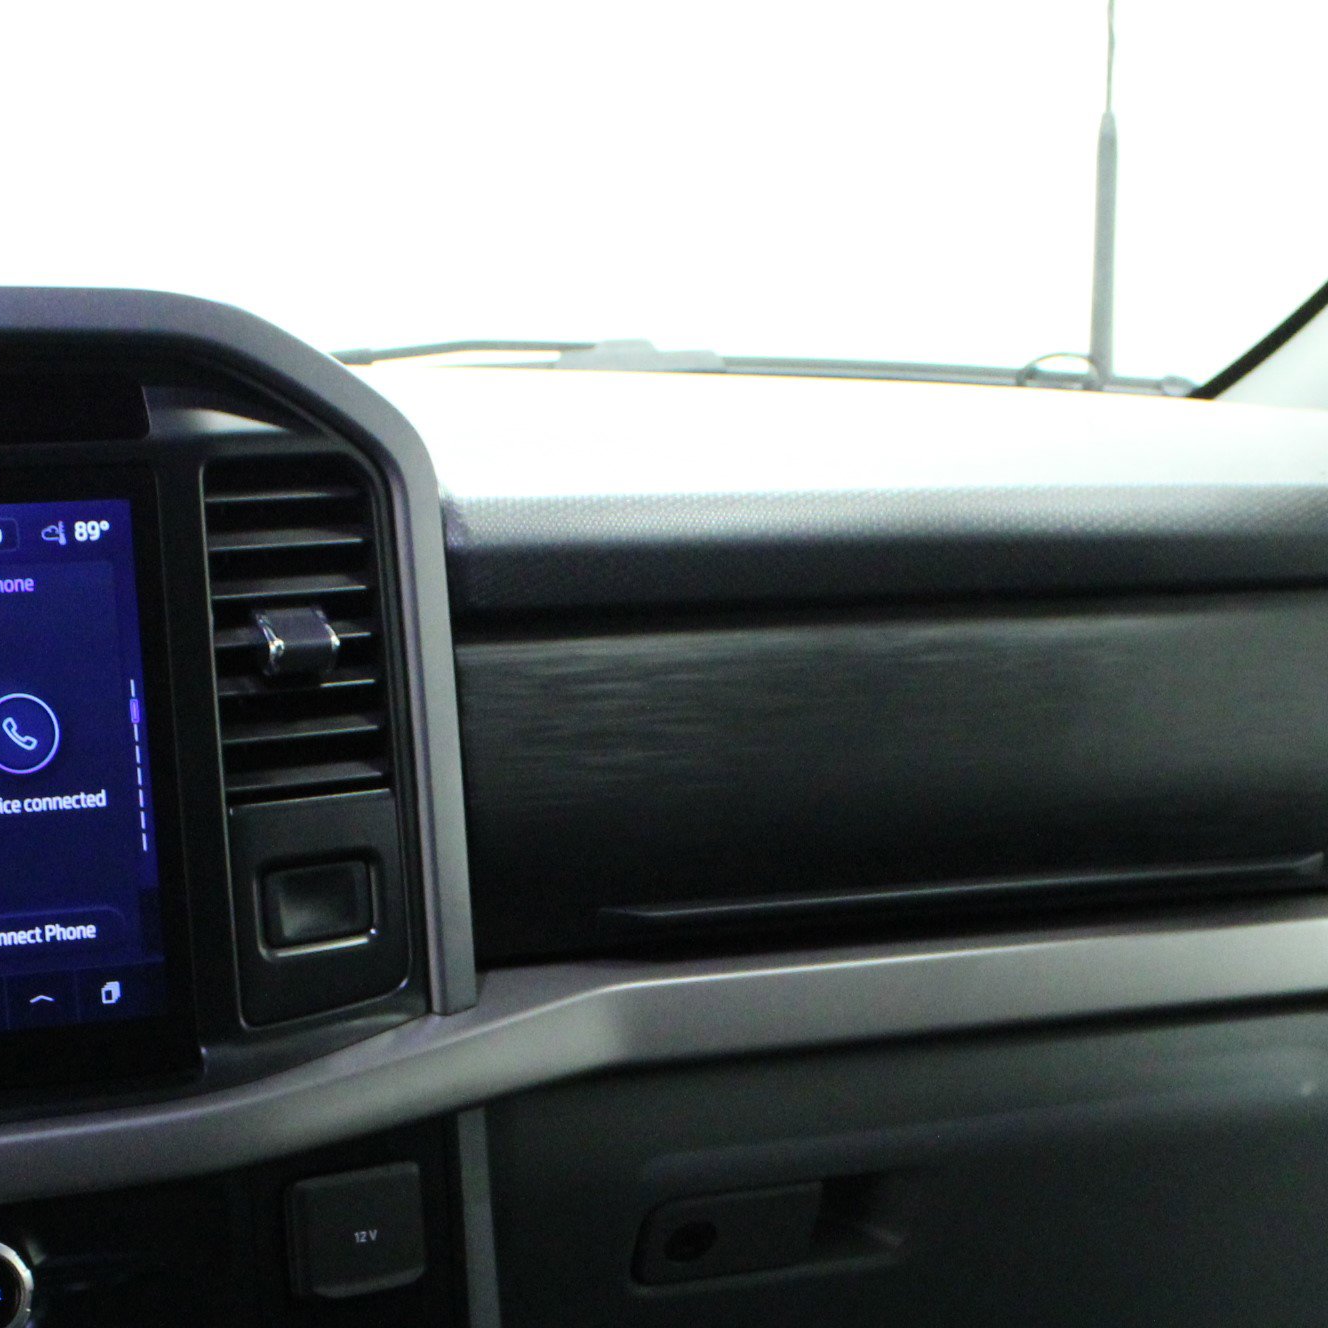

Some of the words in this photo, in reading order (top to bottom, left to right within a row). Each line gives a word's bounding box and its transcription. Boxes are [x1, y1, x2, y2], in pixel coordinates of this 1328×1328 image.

[74, 520, 110, 542] 89°
[23, 789, 107, 812] connected
[44, 923, 97, 943] Phone
